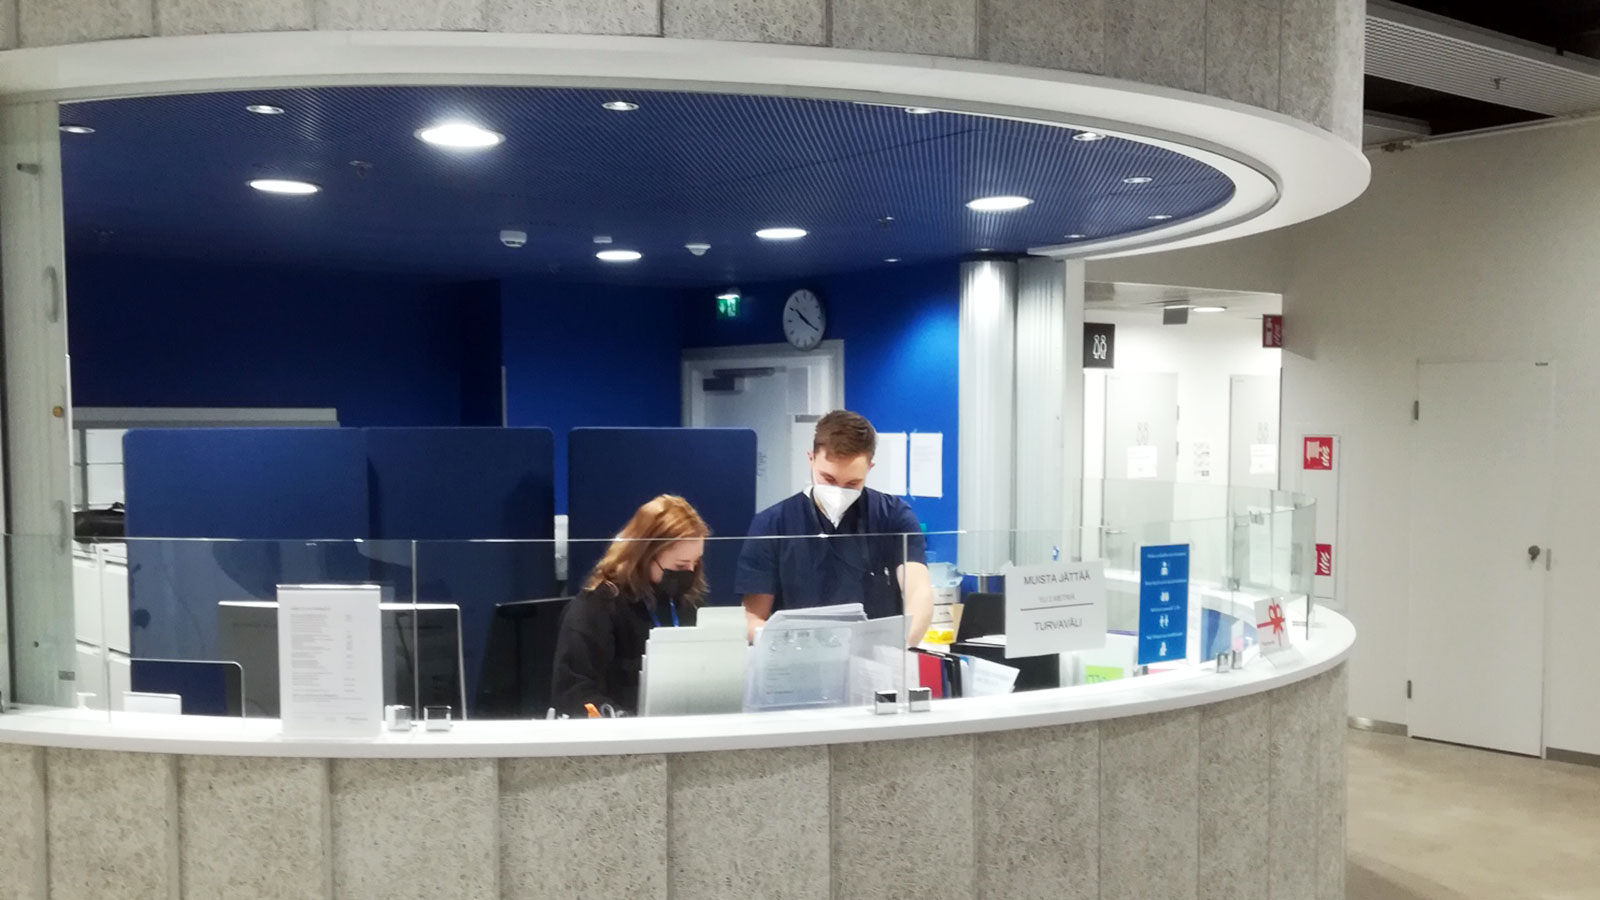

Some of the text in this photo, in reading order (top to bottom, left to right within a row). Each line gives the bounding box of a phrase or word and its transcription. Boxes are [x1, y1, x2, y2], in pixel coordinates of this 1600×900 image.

[1023, 569, 1091, 585] MUISTA JÄTTÄÄ
[1034, 617, 1083, 632] TURVAVÄLI
